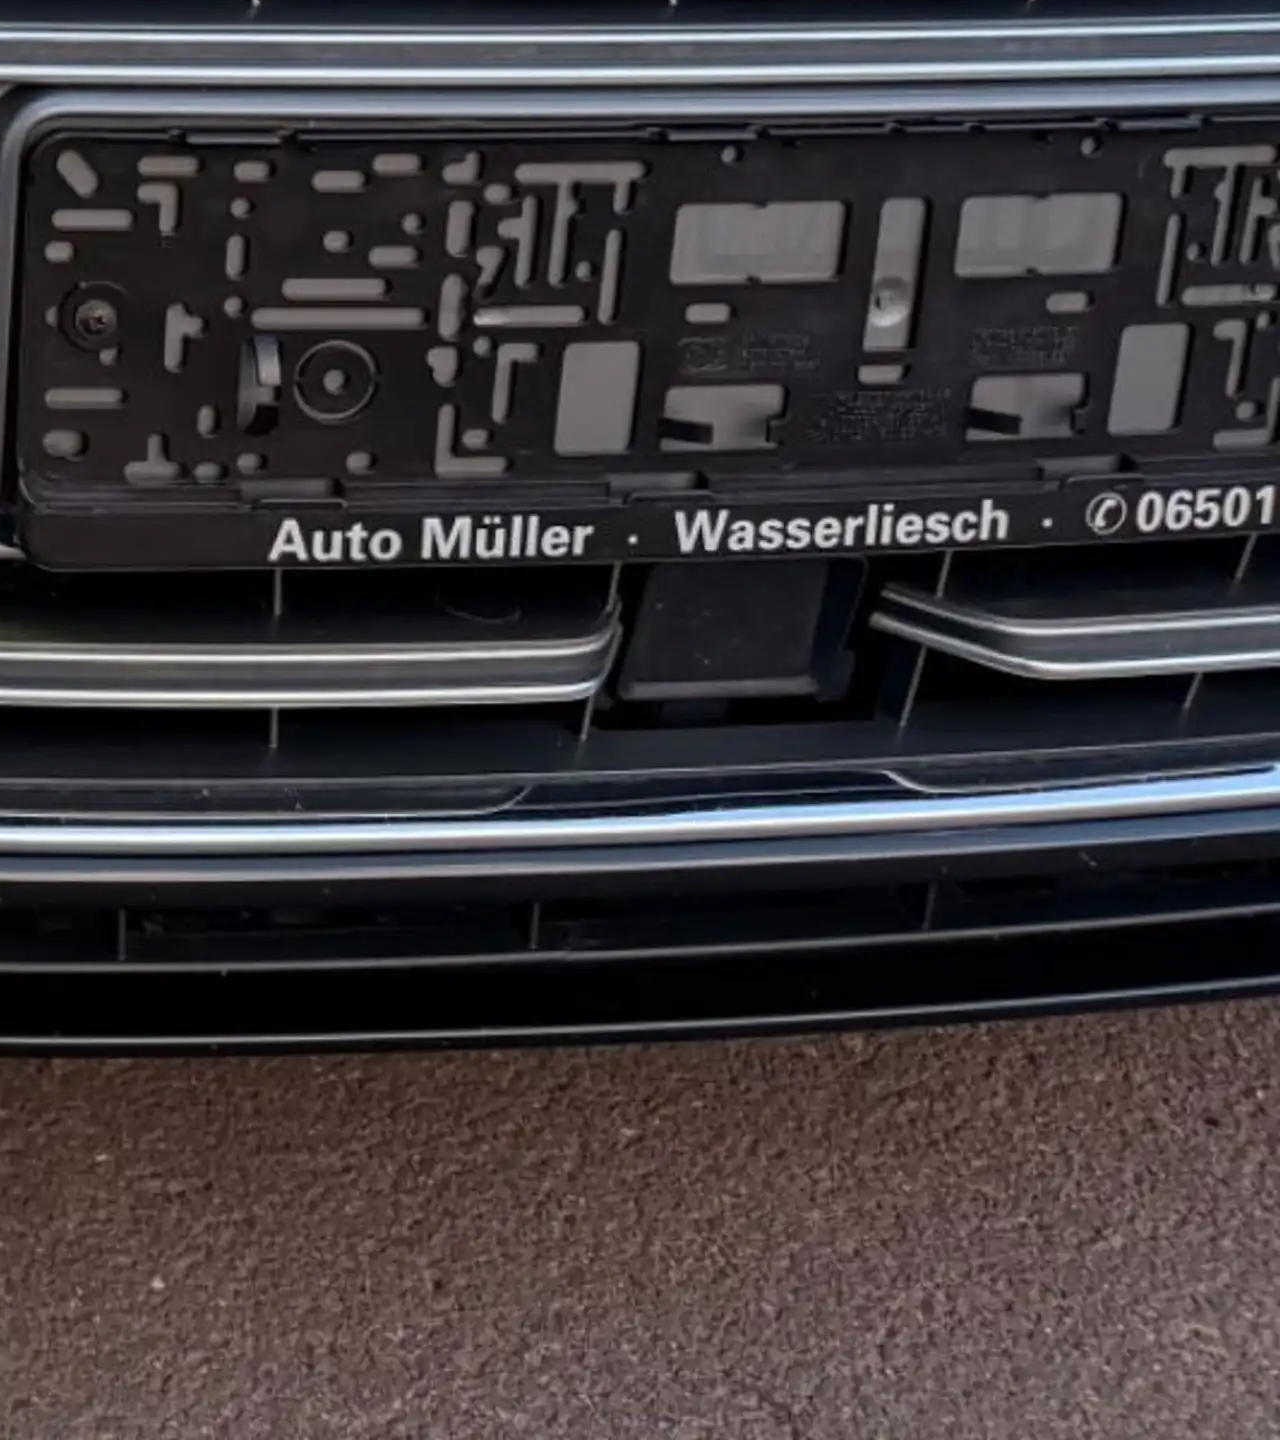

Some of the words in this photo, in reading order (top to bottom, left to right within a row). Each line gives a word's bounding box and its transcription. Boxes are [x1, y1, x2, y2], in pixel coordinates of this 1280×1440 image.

[267, 517, 403, 561] Auto
[420, 513, 594, 560] Müller
[674, 499, 1009, 554] Wasserliesch
[1136, 485, 1277, 533] 06501
